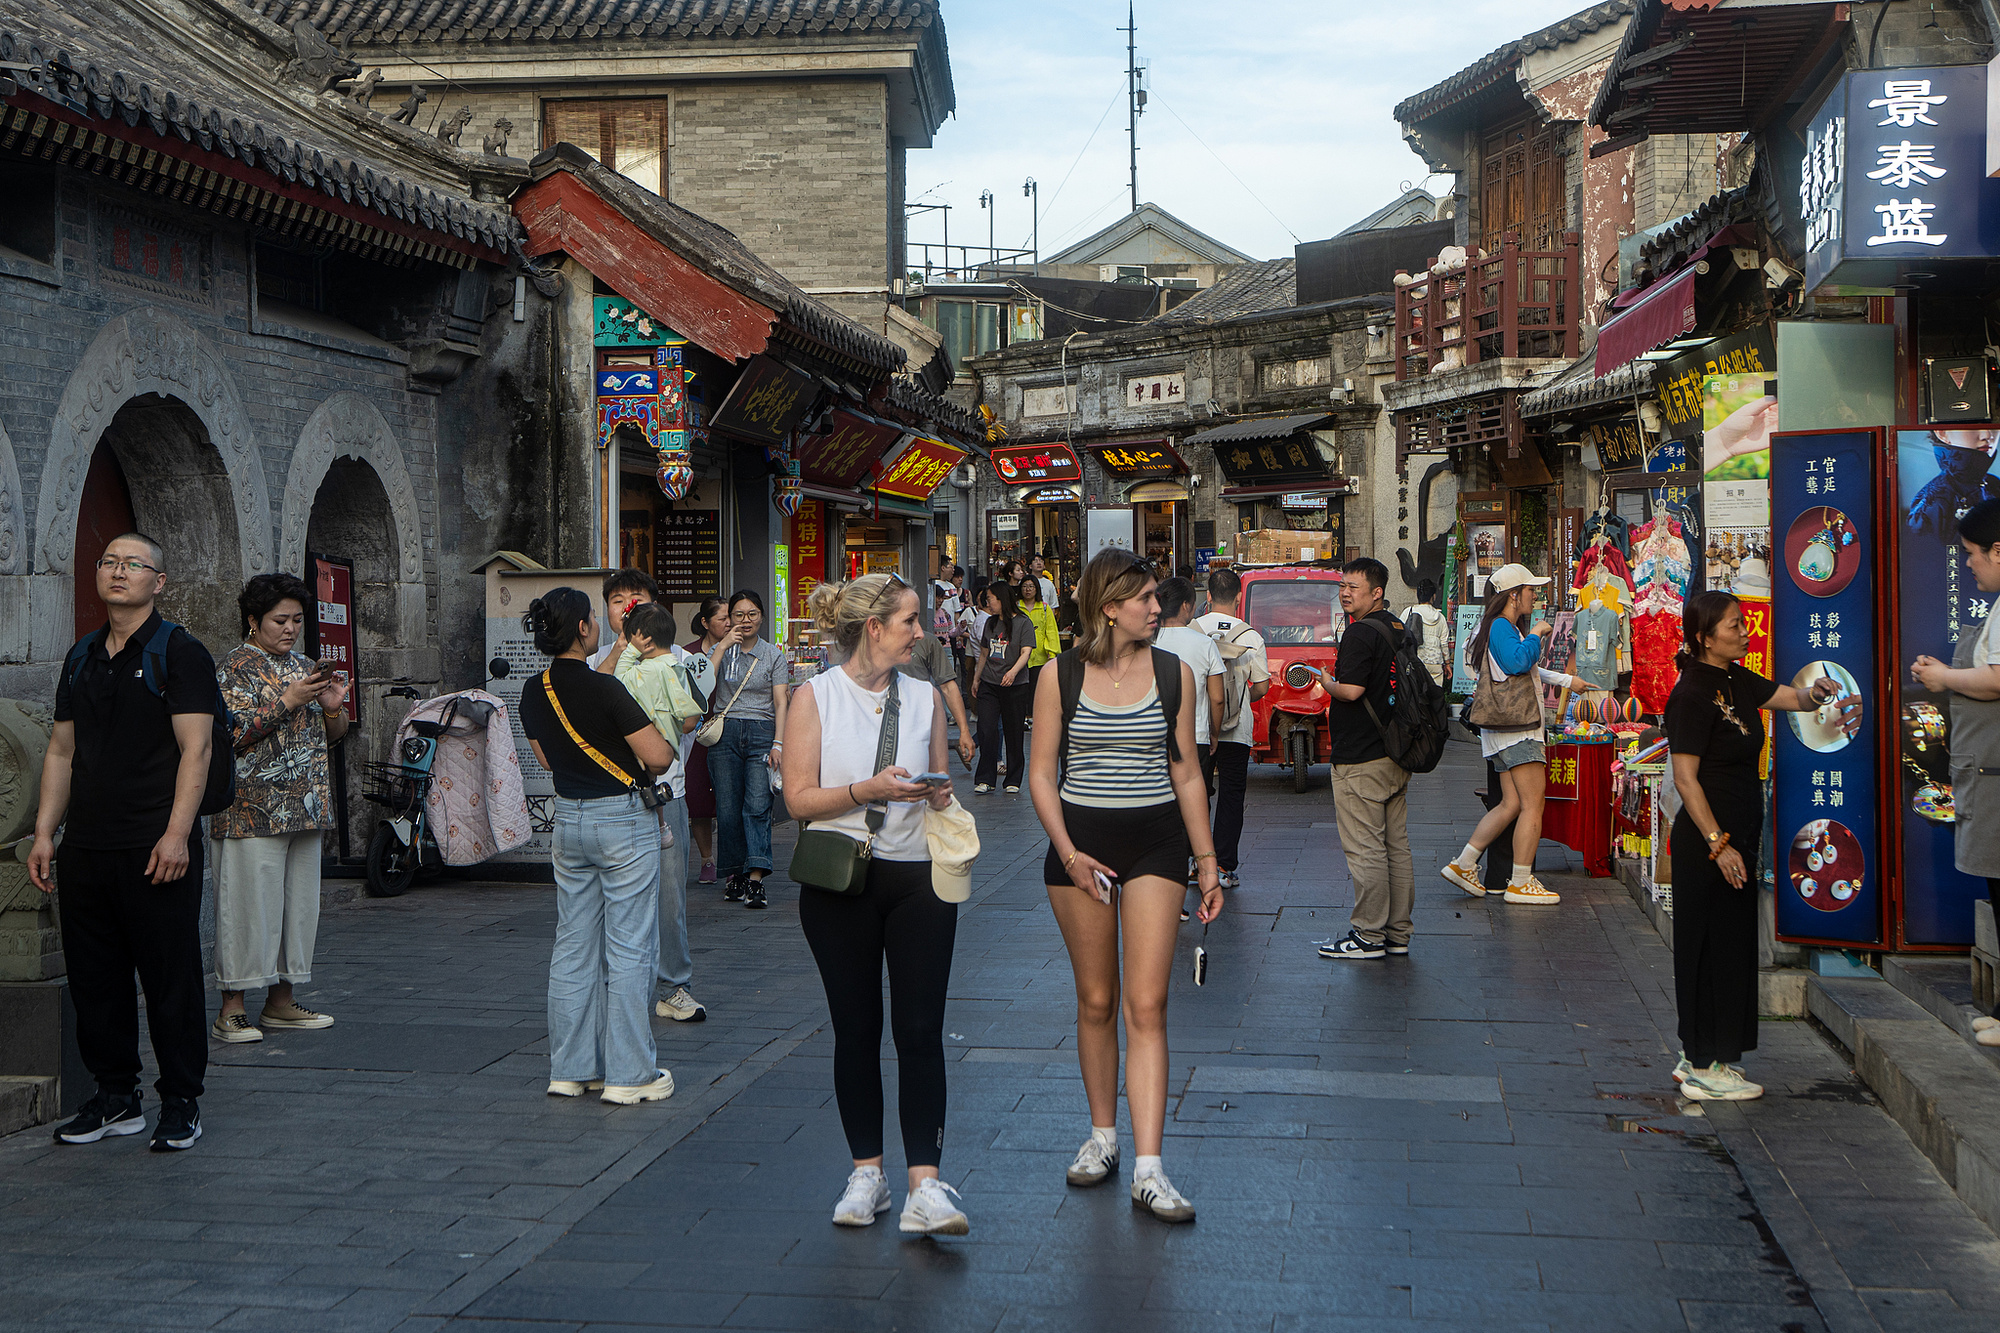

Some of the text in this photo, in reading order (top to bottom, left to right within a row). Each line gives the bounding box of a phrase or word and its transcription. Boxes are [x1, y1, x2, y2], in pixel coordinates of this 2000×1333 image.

[1866, 80, 1948, 247] 景泰蓝
[1726, 489, 1745, 497] 招聘
[1744, 609, 1768, 677] 汉服
[887, 714, 895, 736] ROAD
[1550, 757, 1577, 785] 表演
